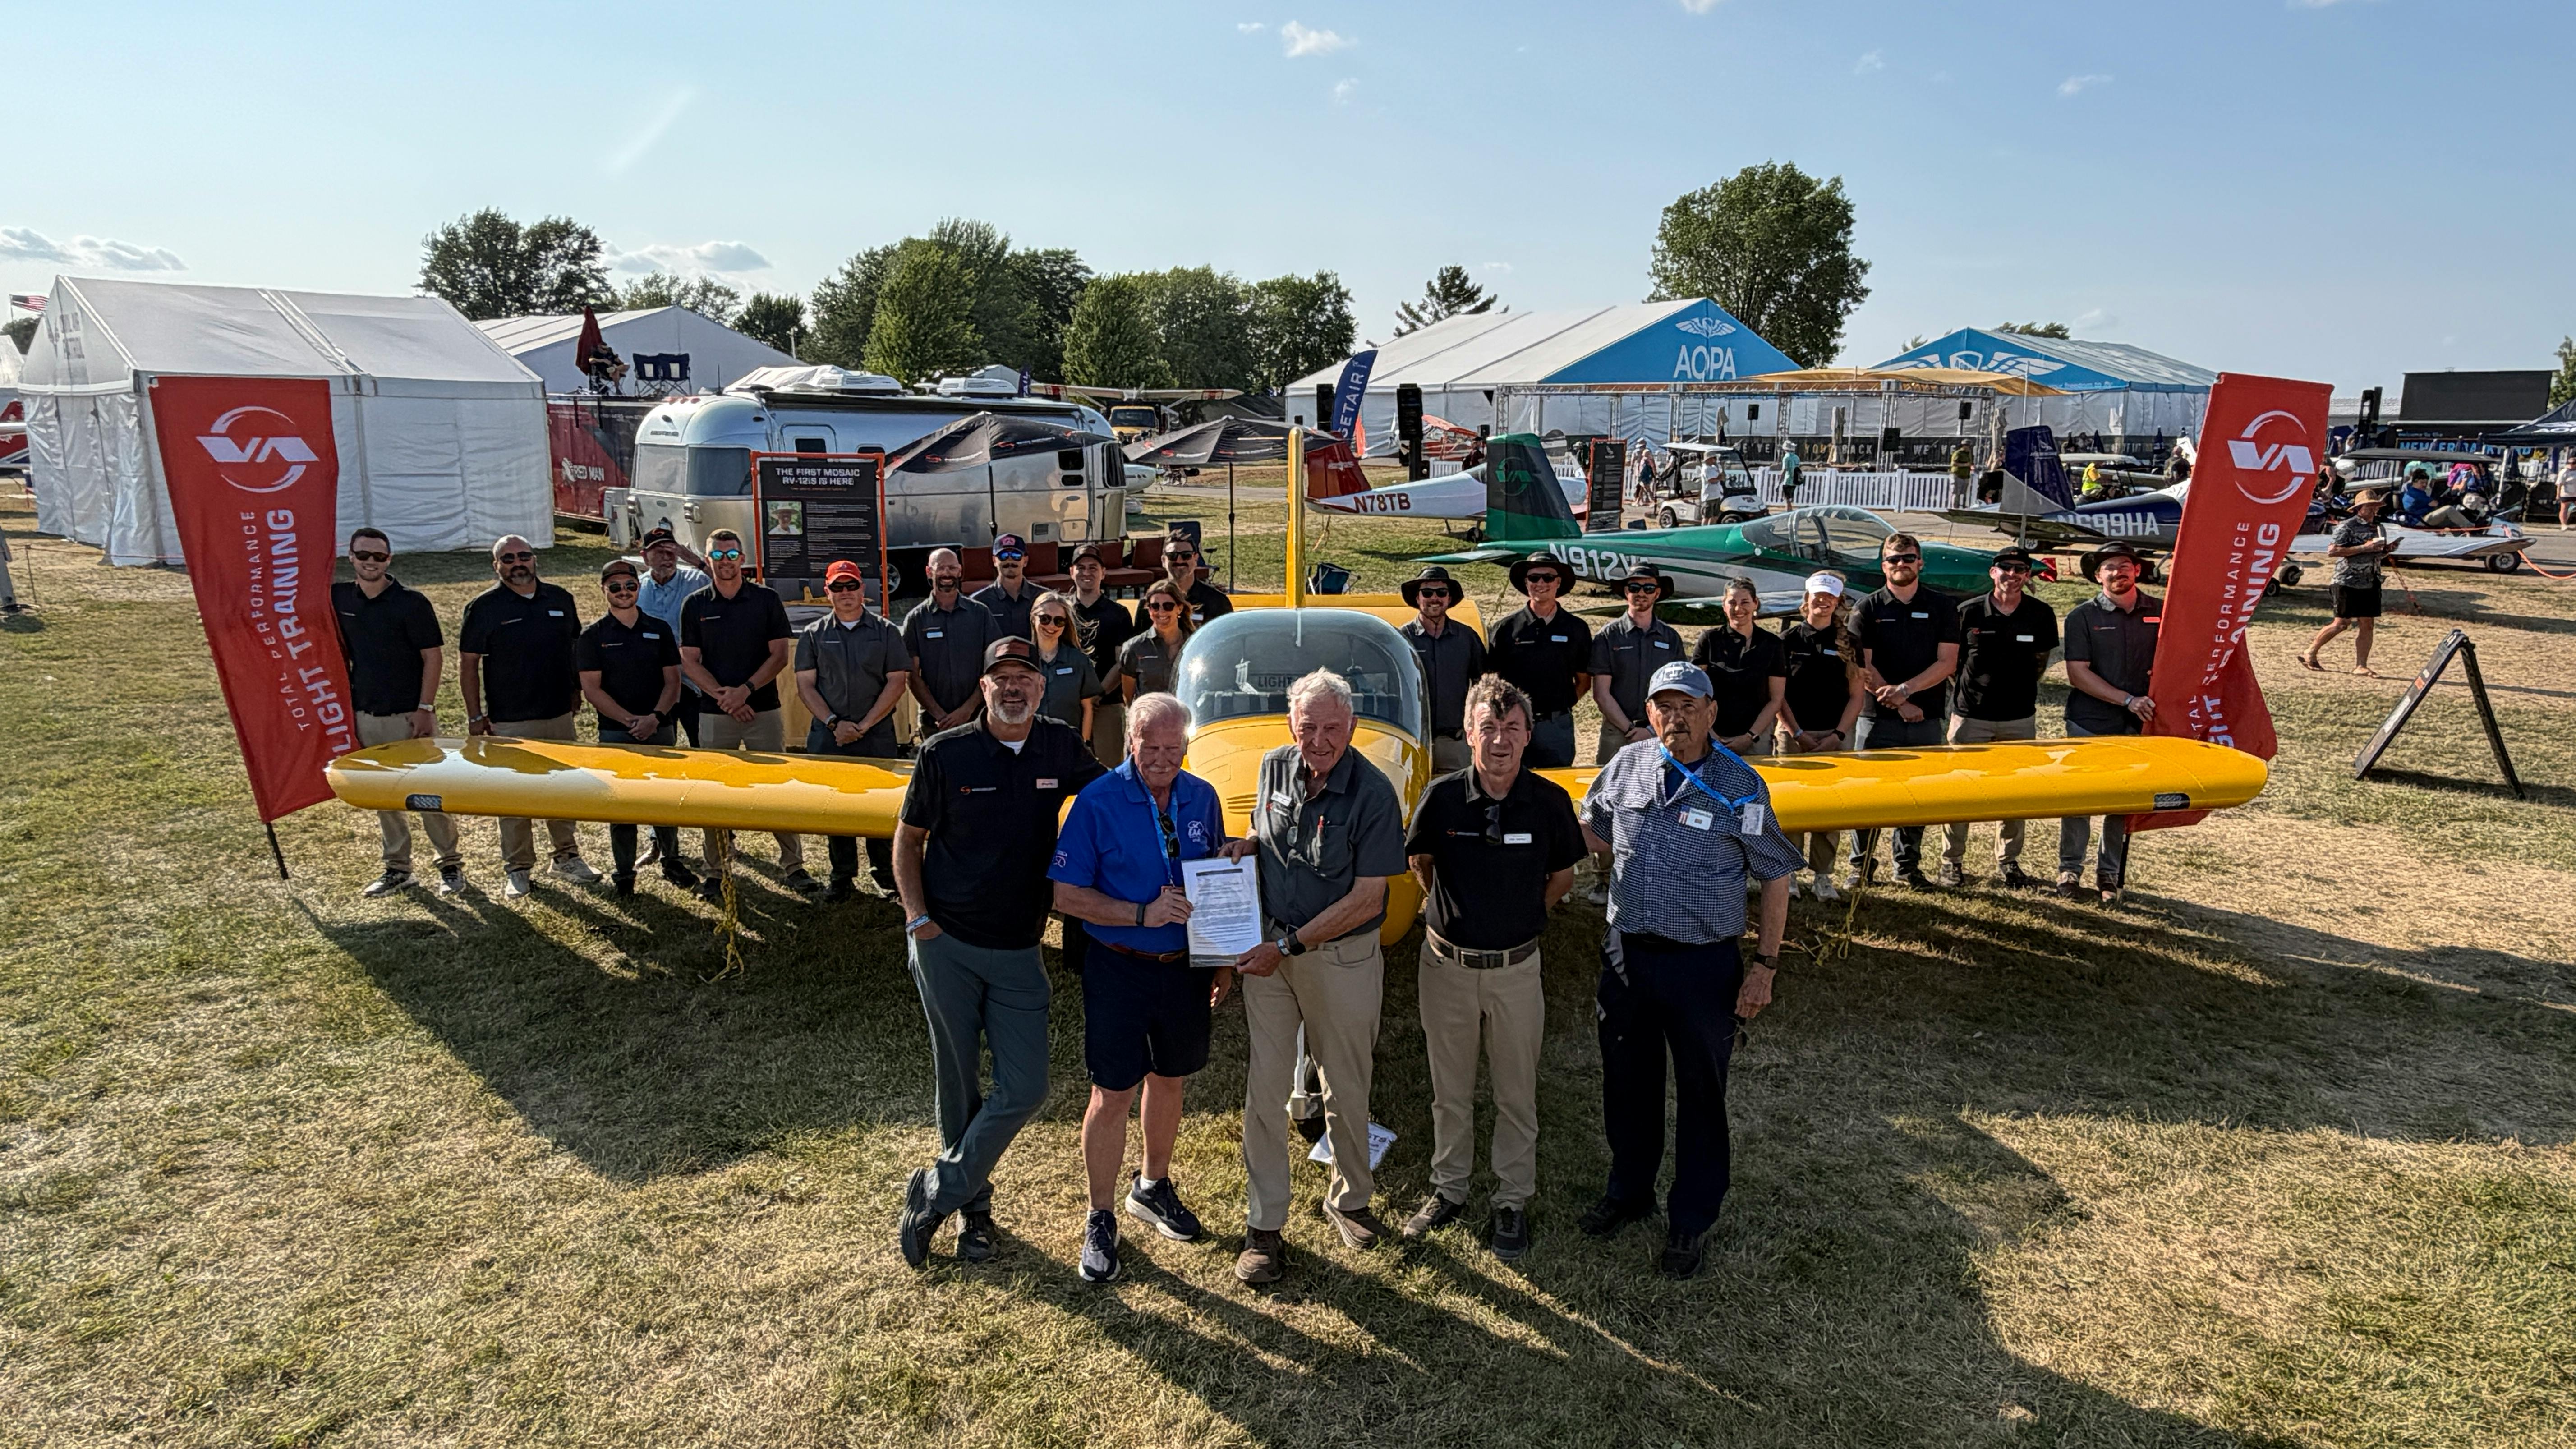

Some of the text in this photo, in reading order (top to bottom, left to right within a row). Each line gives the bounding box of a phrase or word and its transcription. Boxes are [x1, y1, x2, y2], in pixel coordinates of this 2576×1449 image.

[1673, 344, 1736, 380] AOPA
[1743, 443, 1771, 453] E'VE
[2399, 442, 2456, 452] MEMER
[796, 468, 822, 476] FIRST
[823, 469, 860, 477] MOSAIC
[830, 477, 854, 485] HERE
[1353, 491, 1411, 513] N78TB
[1549, 543, 1648, 581] N912V
[240, 511, 311, 731] TOTAL PERFORMANCE
[266, 510, 353, 755] LIGHT TRAINING
